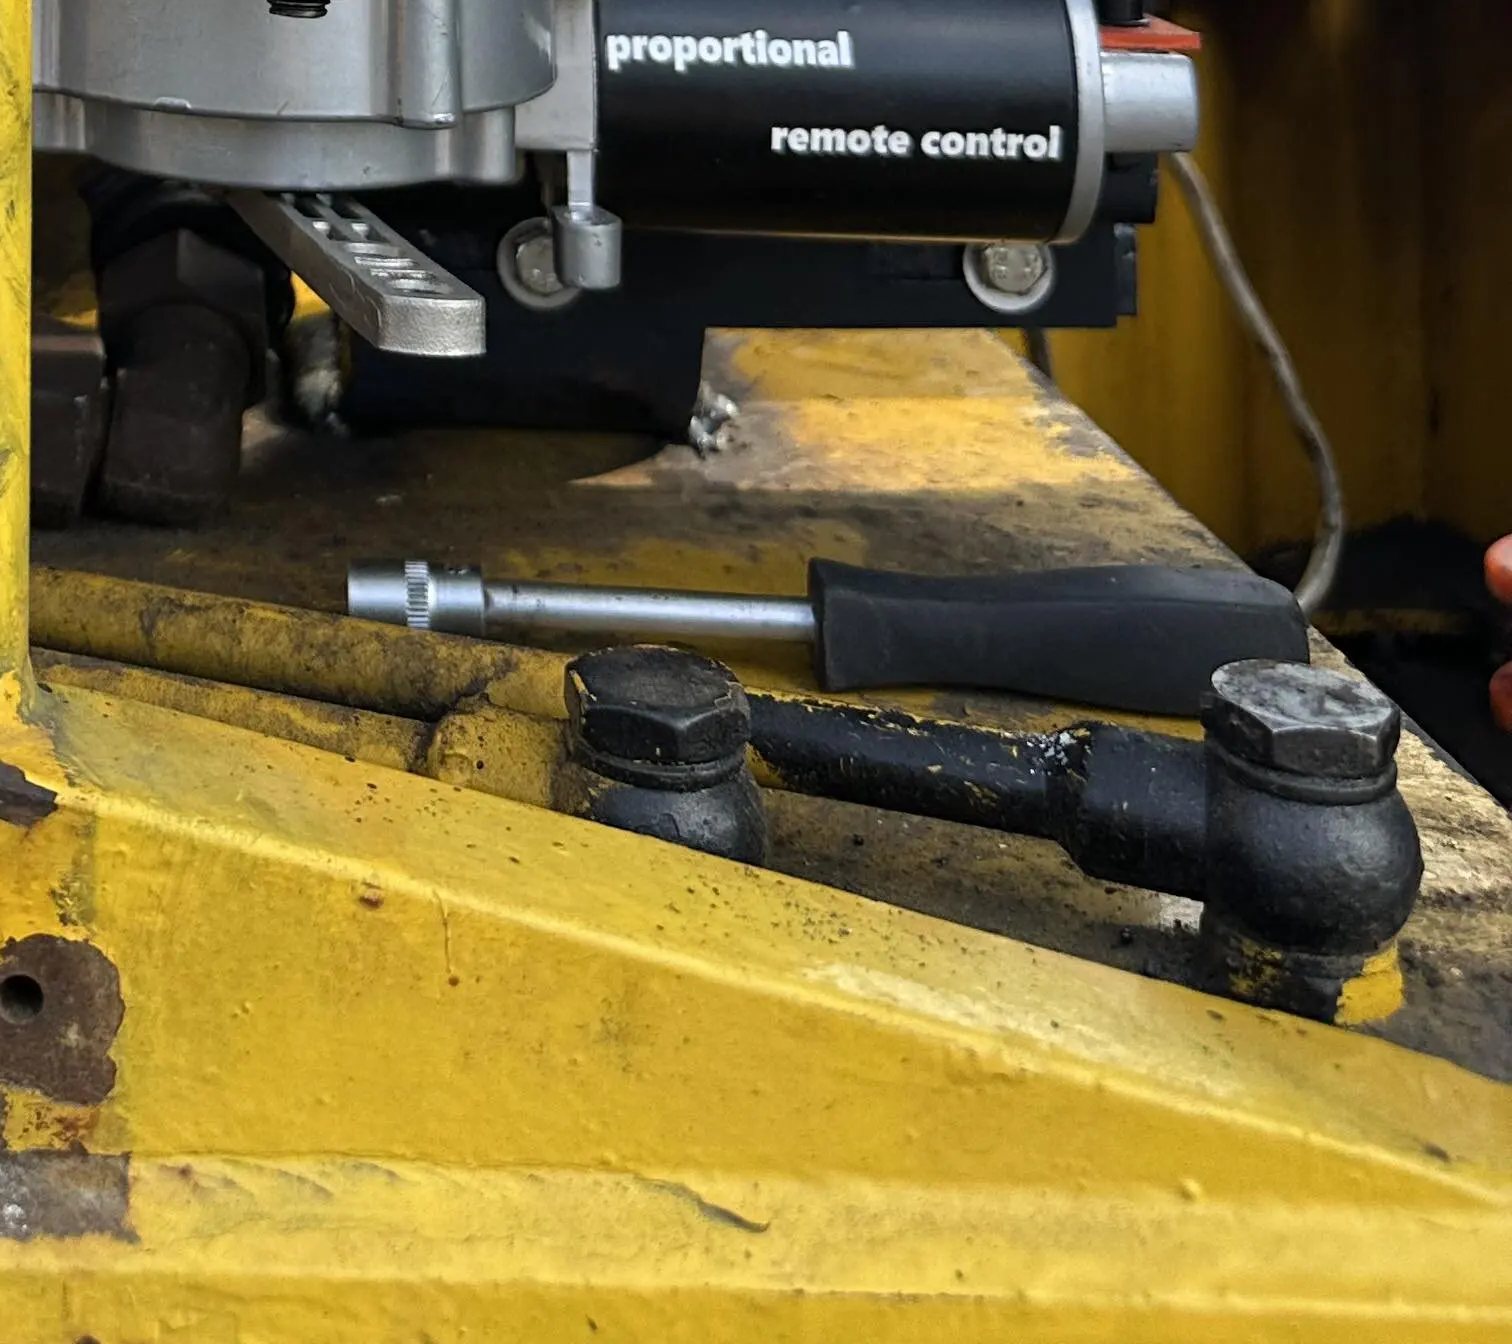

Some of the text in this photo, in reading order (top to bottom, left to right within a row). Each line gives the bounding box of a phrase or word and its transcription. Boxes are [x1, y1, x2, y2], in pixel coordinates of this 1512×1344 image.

[606, 29, 855, 73] proportional
[771, 123, 1061, 160] remote control
